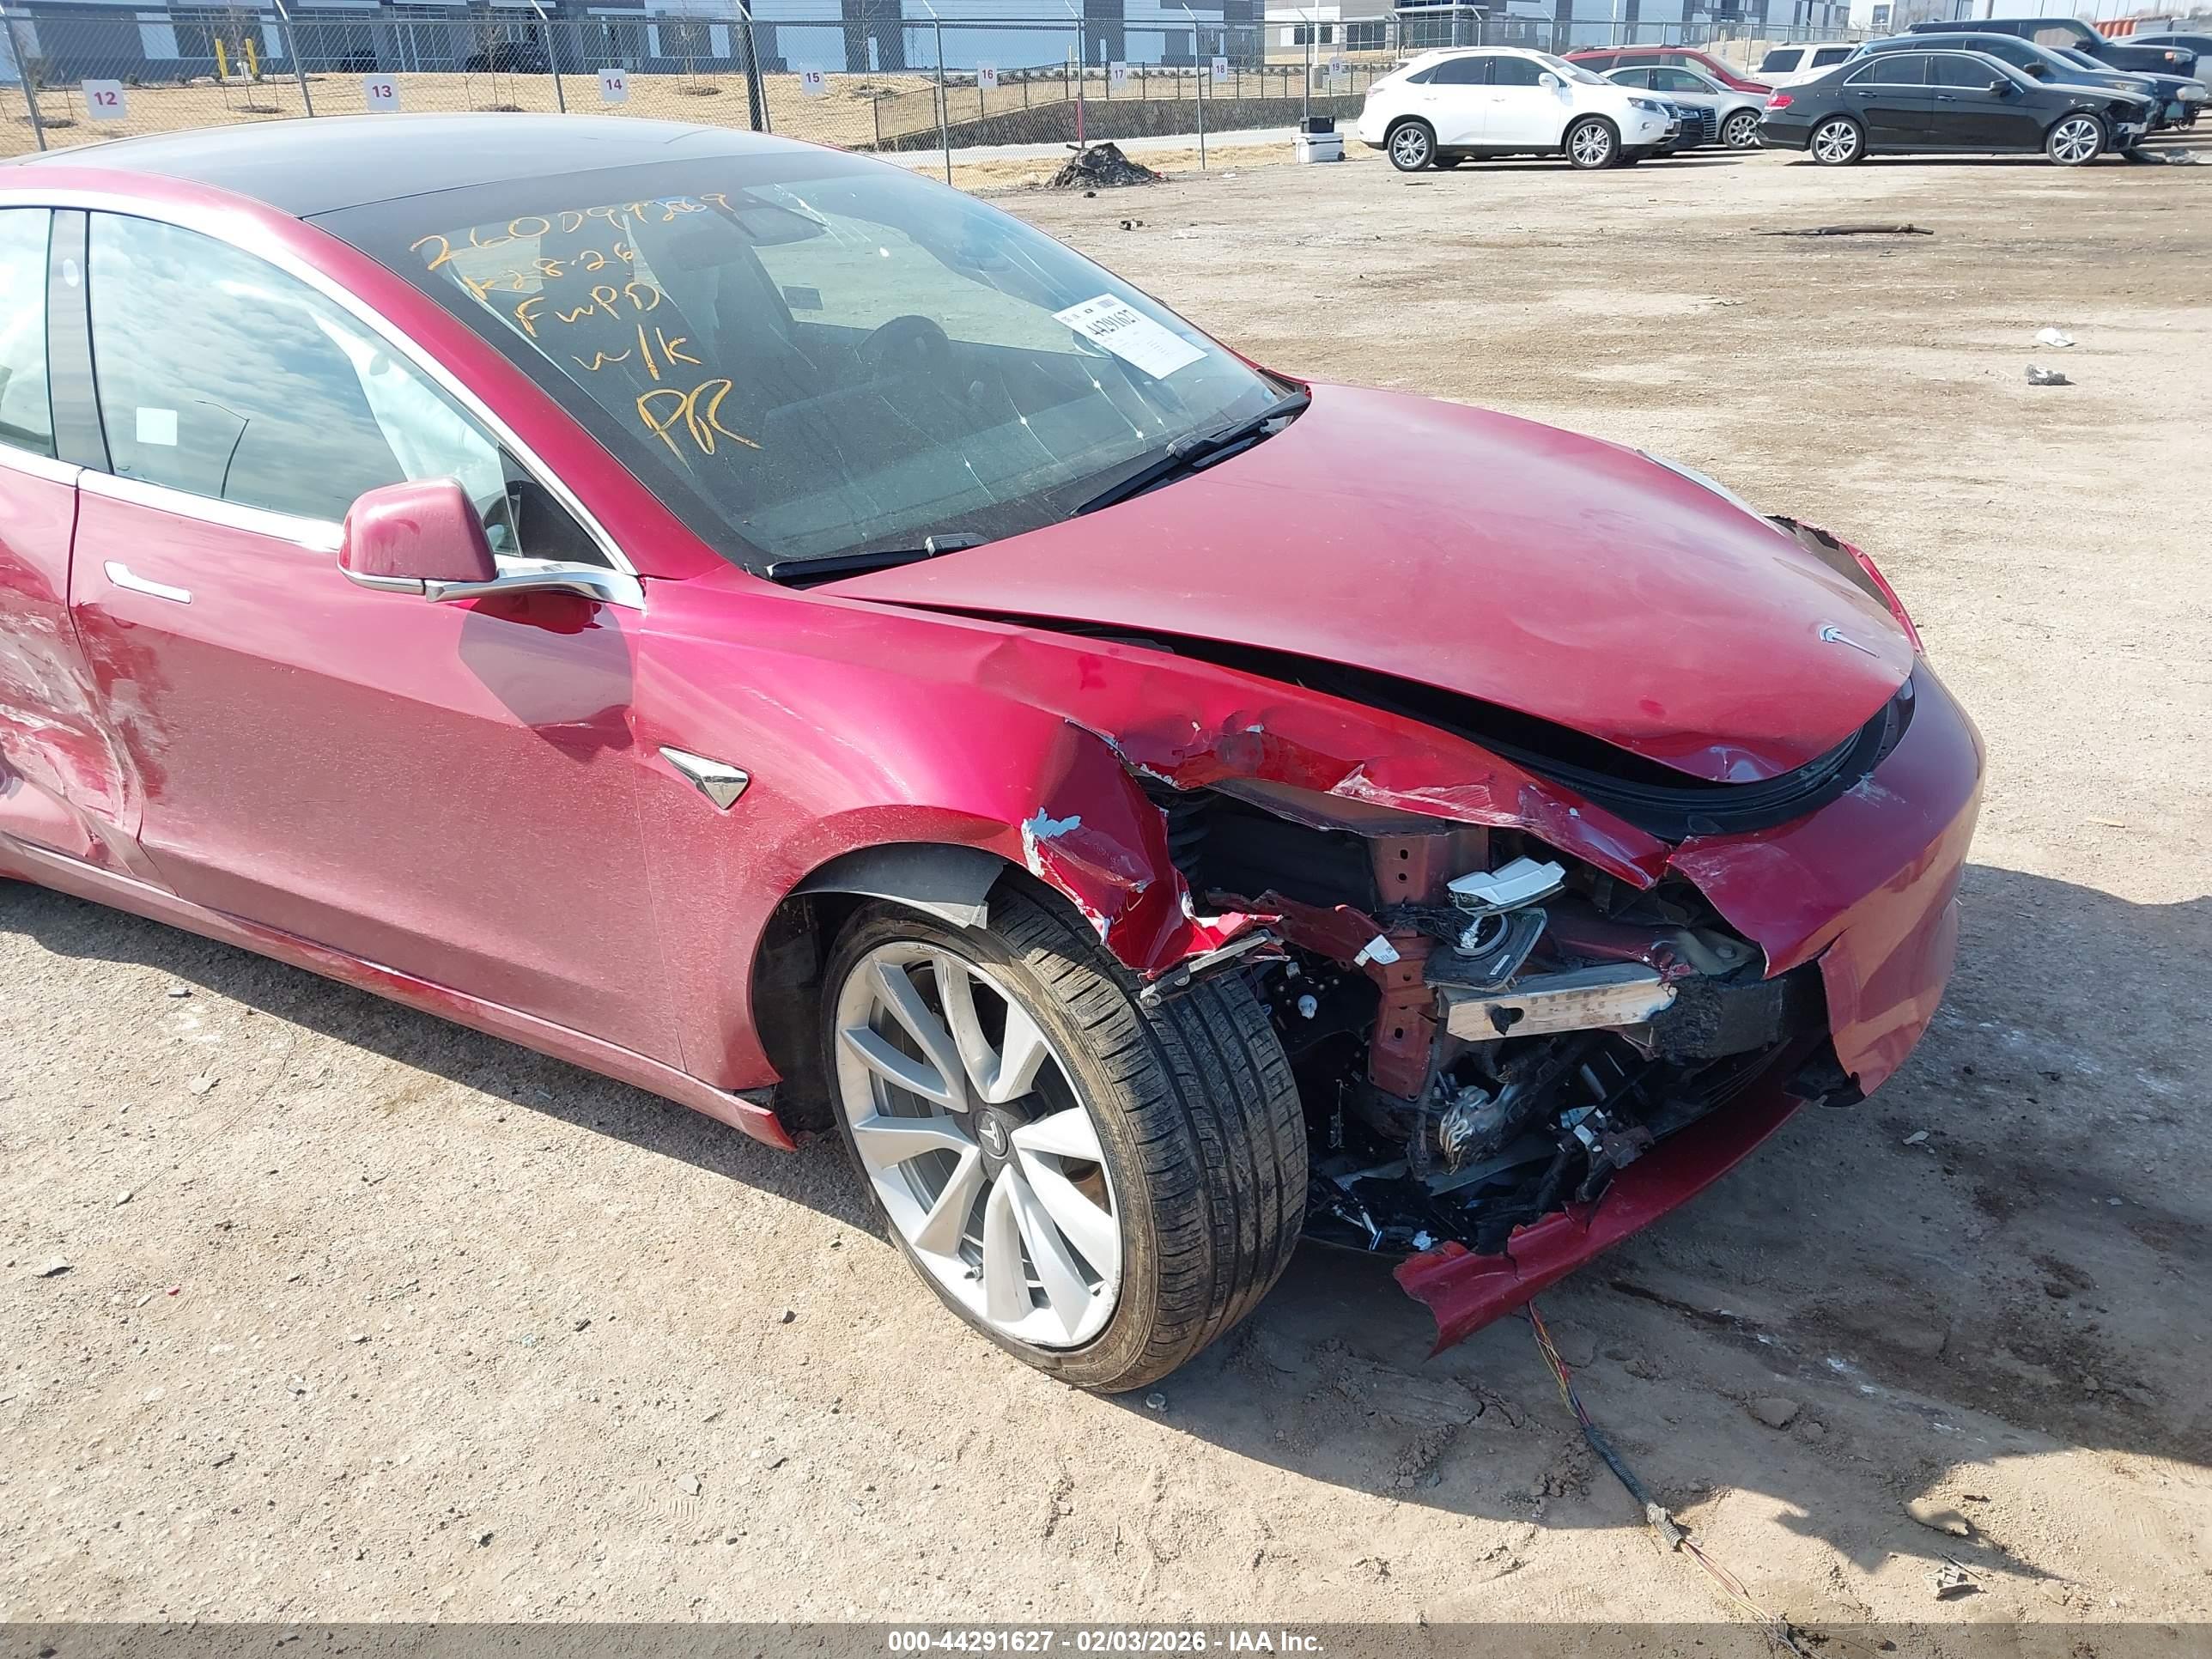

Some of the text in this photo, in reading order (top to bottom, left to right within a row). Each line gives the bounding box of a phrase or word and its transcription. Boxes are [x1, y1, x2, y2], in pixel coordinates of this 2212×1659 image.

[1216, 64, 1225, 74] 18
[1332, 62, 1340, 71] 19
[805, 72, 820, 83] 15
[981, 69, 994, 79] 16
[1115, 69, 1124, 79] 17
[605, 79, 623, 90] 14
[372, 85, 392, 98] 13
[94, 91, 118, 106] 12
[1085, 309, 1141, 336] 44291627
